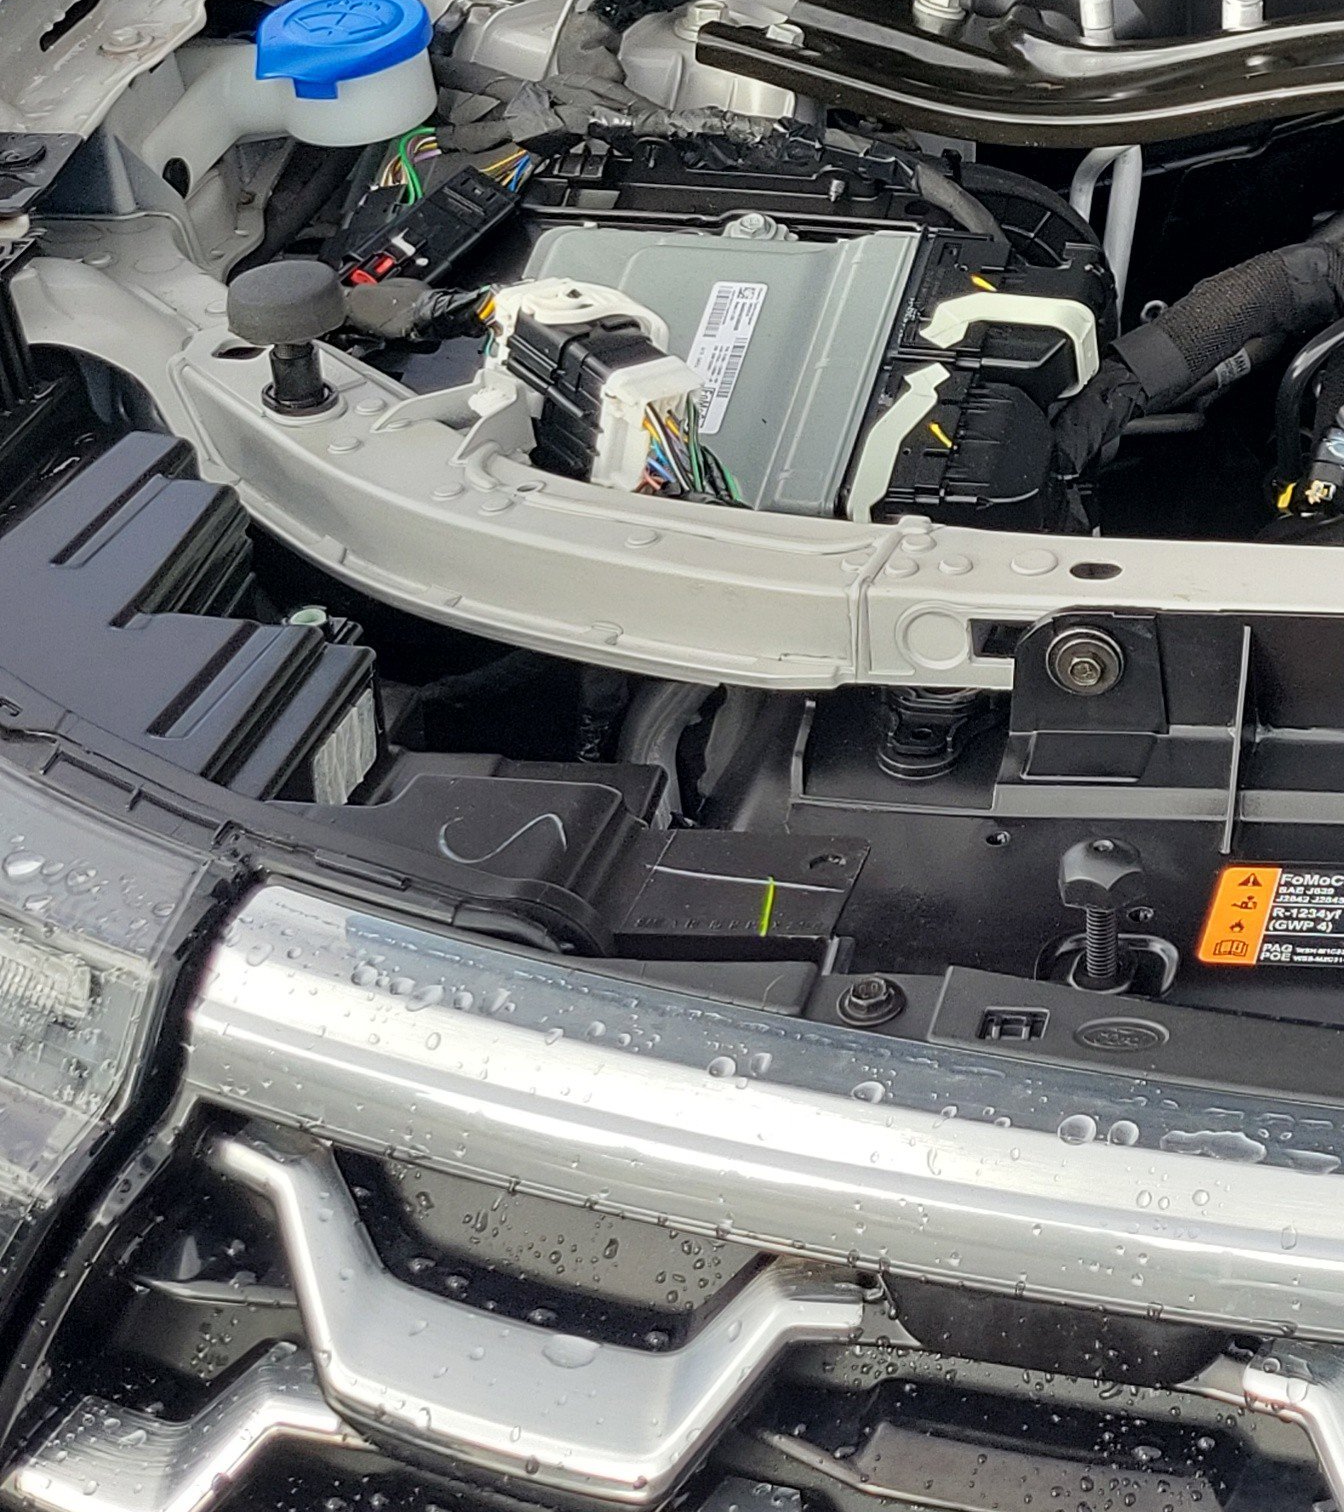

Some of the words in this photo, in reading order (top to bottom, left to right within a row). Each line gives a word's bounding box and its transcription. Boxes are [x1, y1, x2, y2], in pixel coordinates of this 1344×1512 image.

[1279, 887, 1304, 895] SAE
[1272, 907, 1343, 921] R-1234yf
[1268, 920, 1315, 931] (GWP
[1316, 921, 1333, 933] 4)
[1262, 943, 1293, 953] PAG
[1260, 951, 1292, 961] POE
